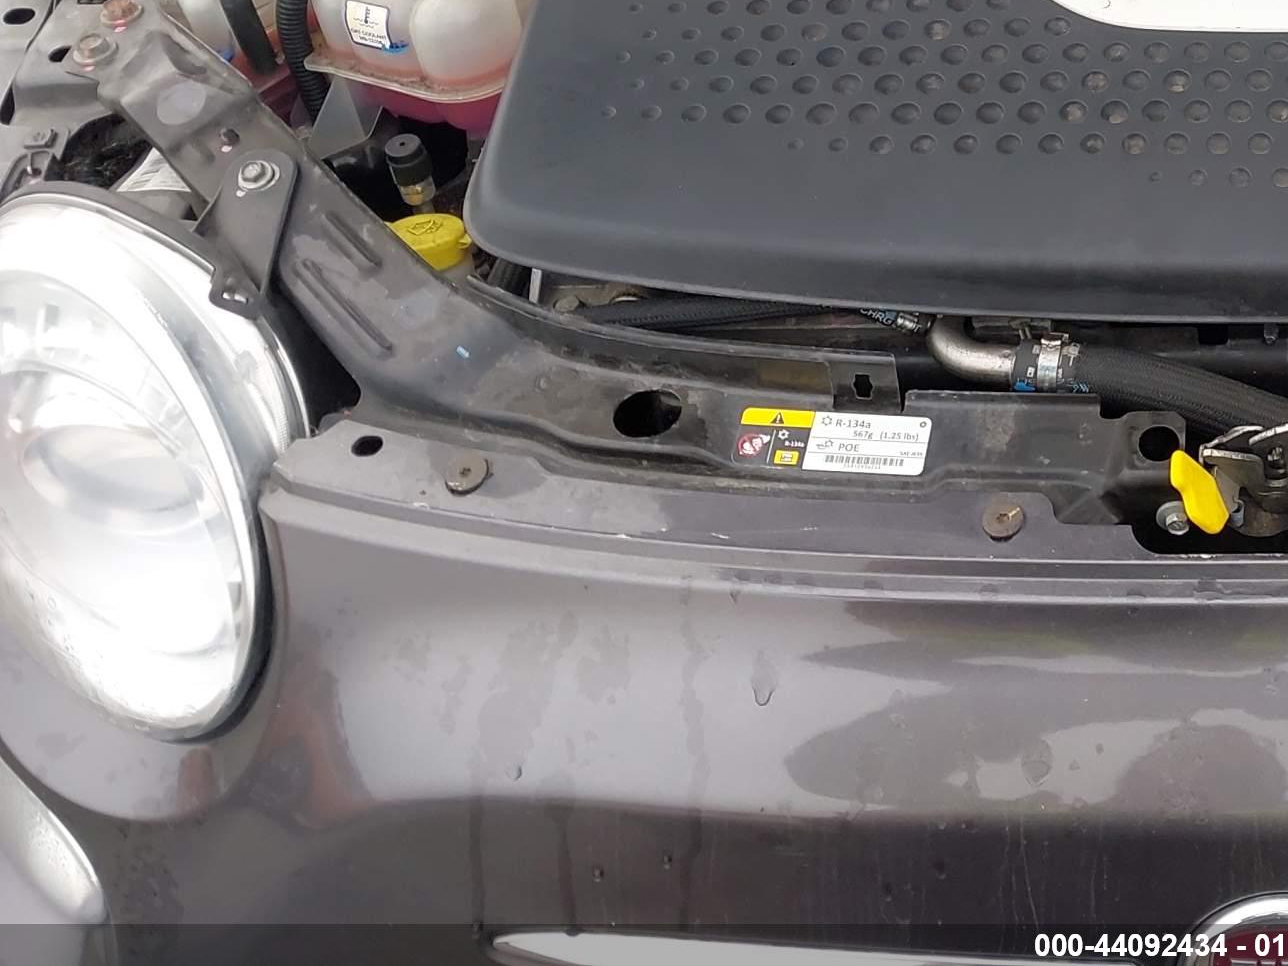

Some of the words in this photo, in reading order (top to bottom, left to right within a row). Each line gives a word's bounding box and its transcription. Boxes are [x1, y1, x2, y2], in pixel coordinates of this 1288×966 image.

[835, 418, 871, 429] R-134a
[852, 430, 873, 440] 567g
[903, 431, 919, 442] lbs)
[838, 442, 860, 452] POE
